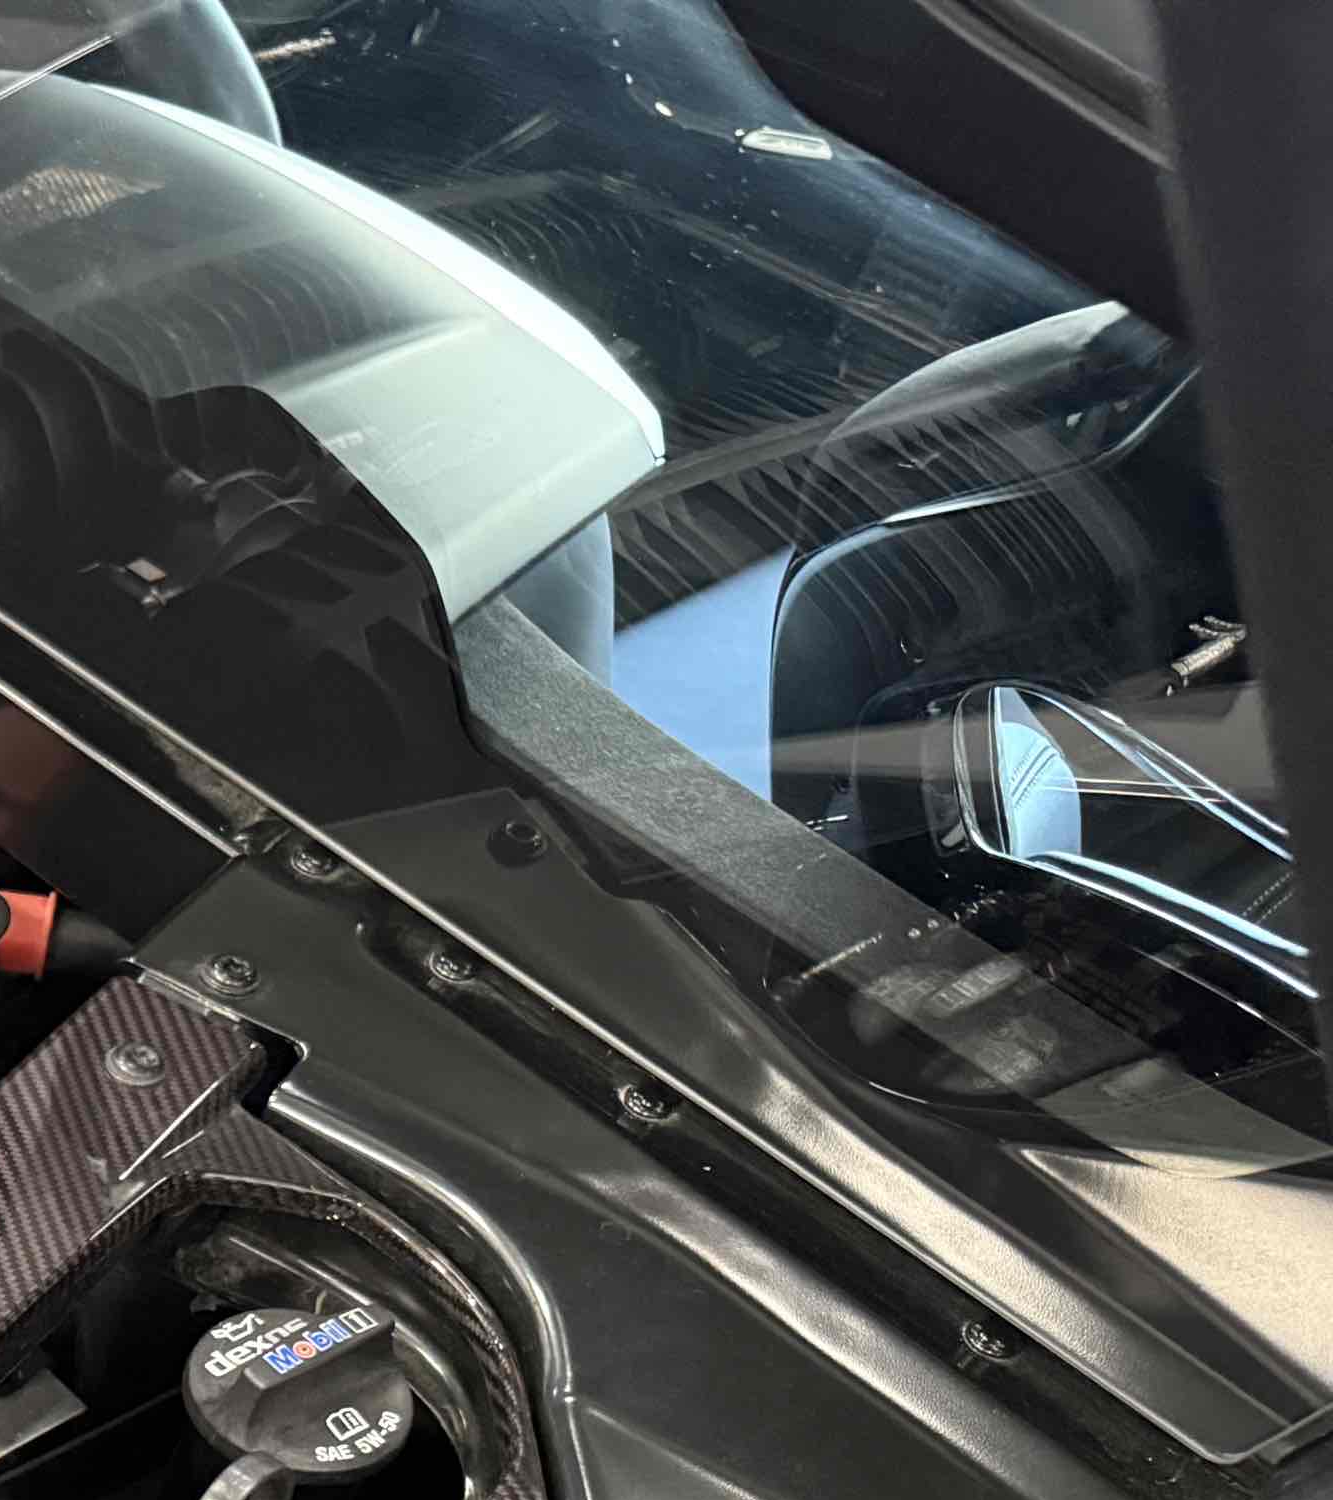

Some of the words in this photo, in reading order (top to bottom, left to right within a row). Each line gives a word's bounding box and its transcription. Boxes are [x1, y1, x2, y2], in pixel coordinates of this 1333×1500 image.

[262, 1318, 352, 1374] Mobil
[315, 1444, 355, 1462] SAE
[354, 1411, 400, 1454] 5W-50
